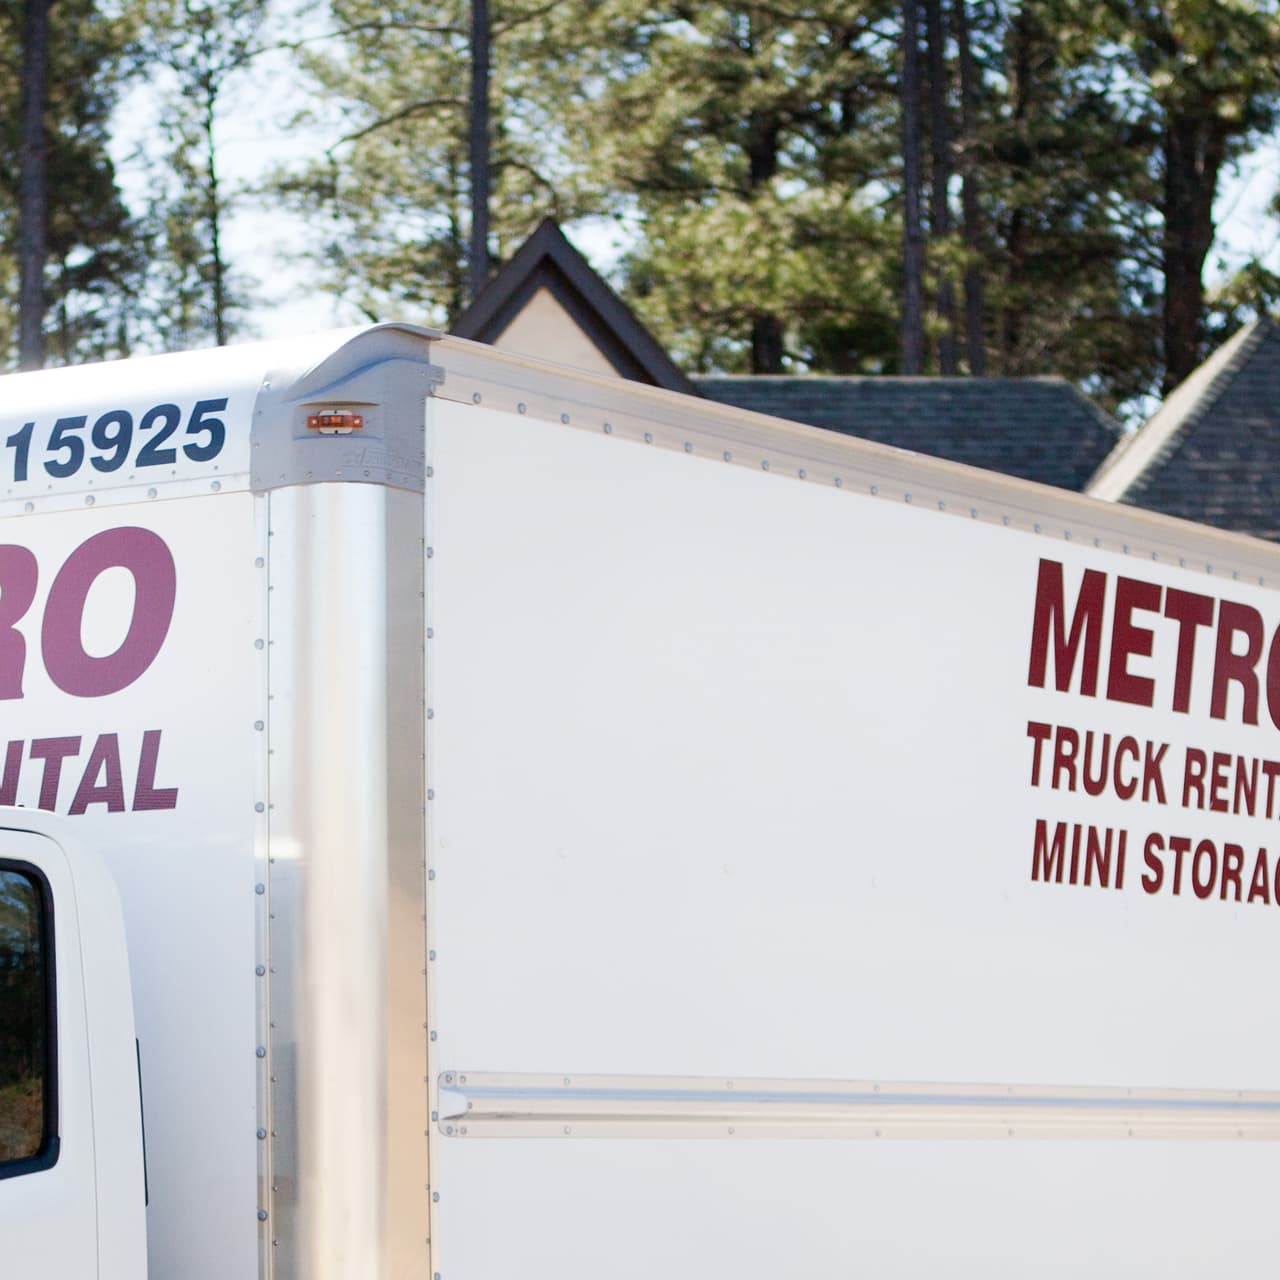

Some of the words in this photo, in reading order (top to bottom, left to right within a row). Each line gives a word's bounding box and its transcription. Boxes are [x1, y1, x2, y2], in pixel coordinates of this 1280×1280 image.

[5, 397, 228, 482] 15925
[1026, 721, 1169, 804] TRUCK
[1031, 819, 1128, 890] MINI
